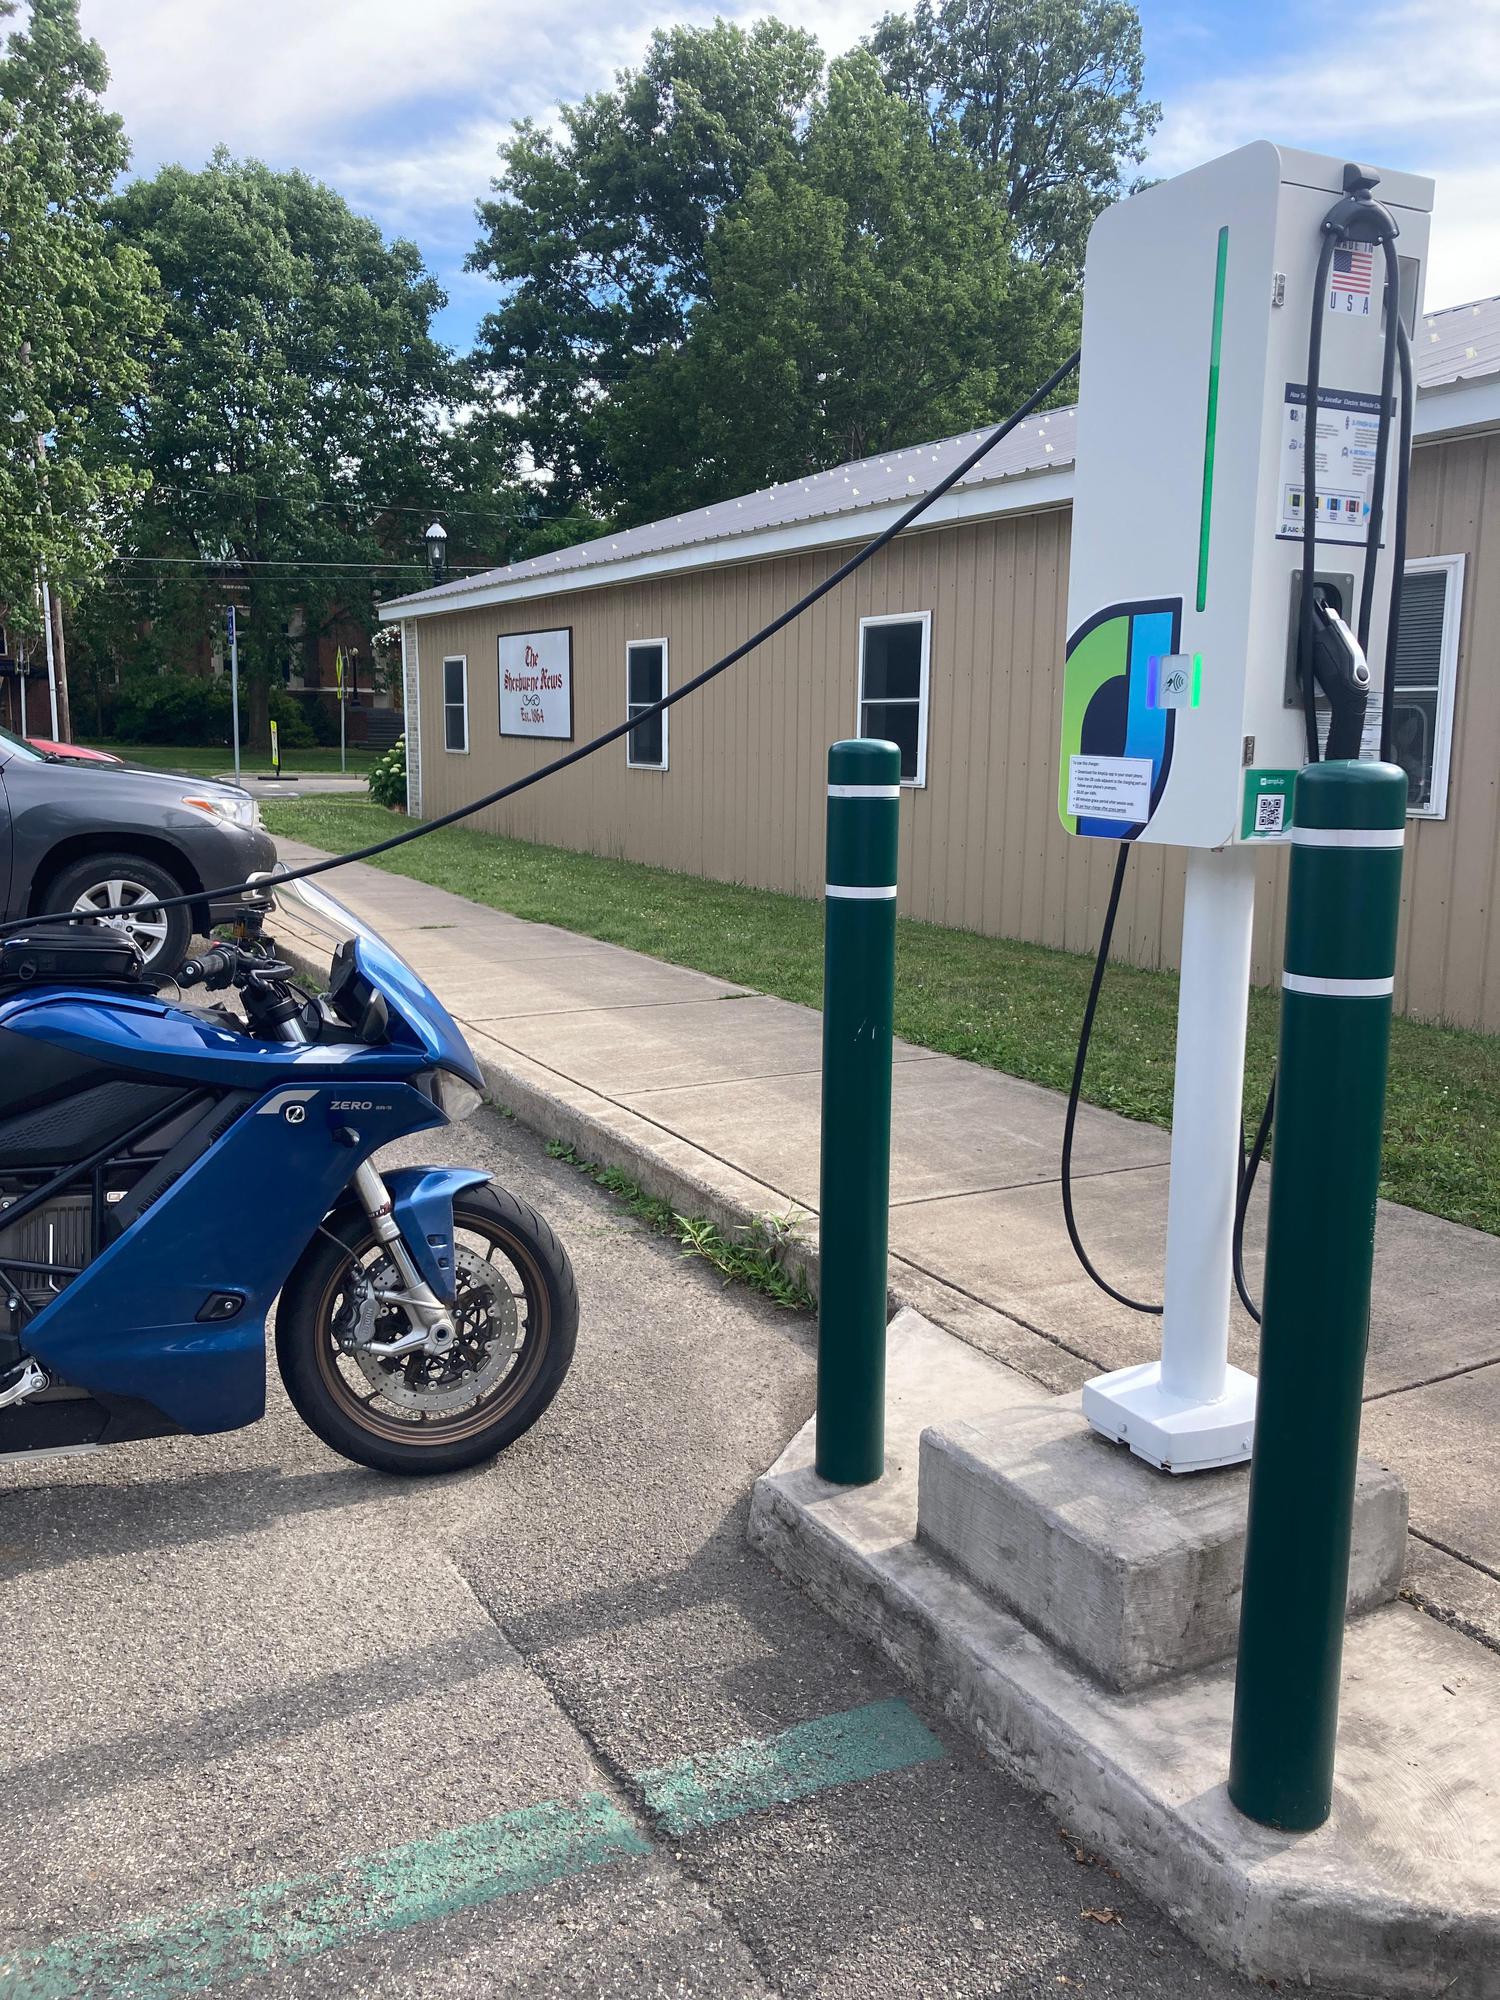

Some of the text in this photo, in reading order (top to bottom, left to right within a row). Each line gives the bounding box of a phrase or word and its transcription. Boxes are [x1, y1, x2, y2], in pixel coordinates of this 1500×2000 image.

[525, 645, 539, 668] The
[504, 667, 563, 693] Sherburne News
[330, 1100, 373, 1110] ZERO
